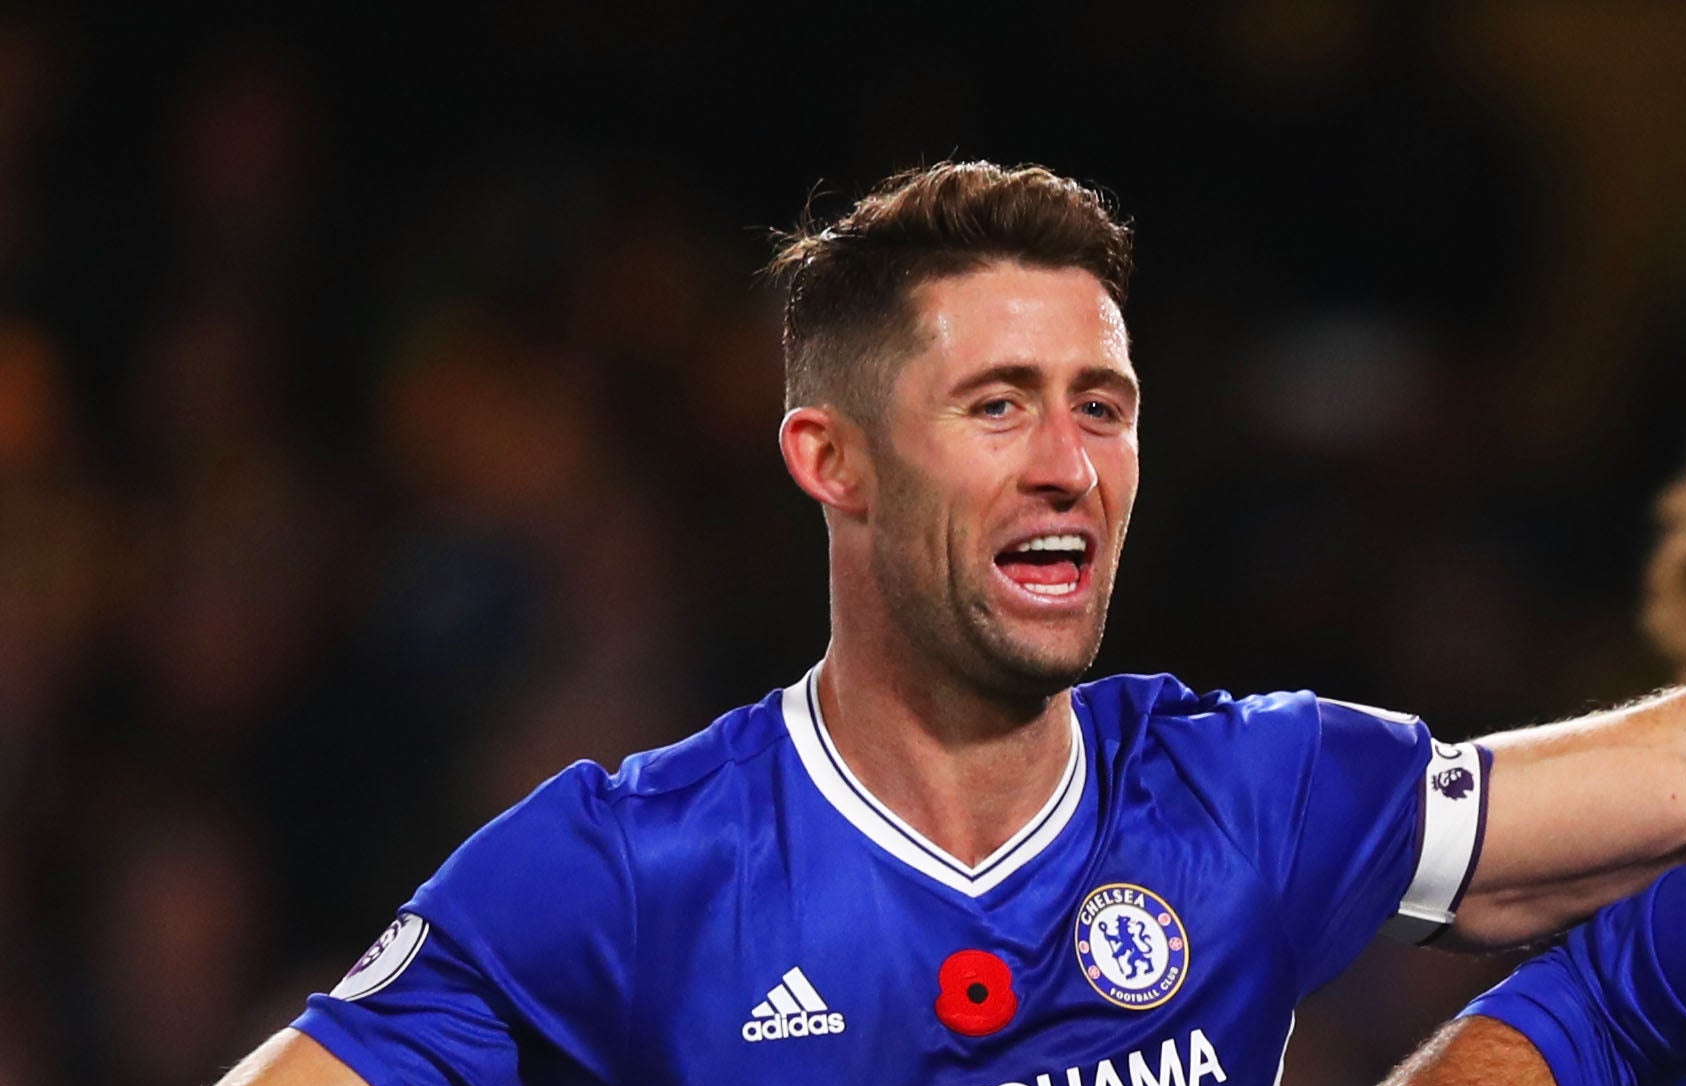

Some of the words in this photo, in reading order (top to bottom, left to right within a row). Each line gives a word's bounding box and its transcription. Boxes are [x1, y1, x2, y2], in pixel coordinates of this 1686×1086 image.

[1081, 889, 1145, 925] CHELSEA
[1110, 987, 1160, 1002] FOOTBALL
[1160, 966, 1179, 991] CLUB
[742, 1009, 845, 1042] adidas
